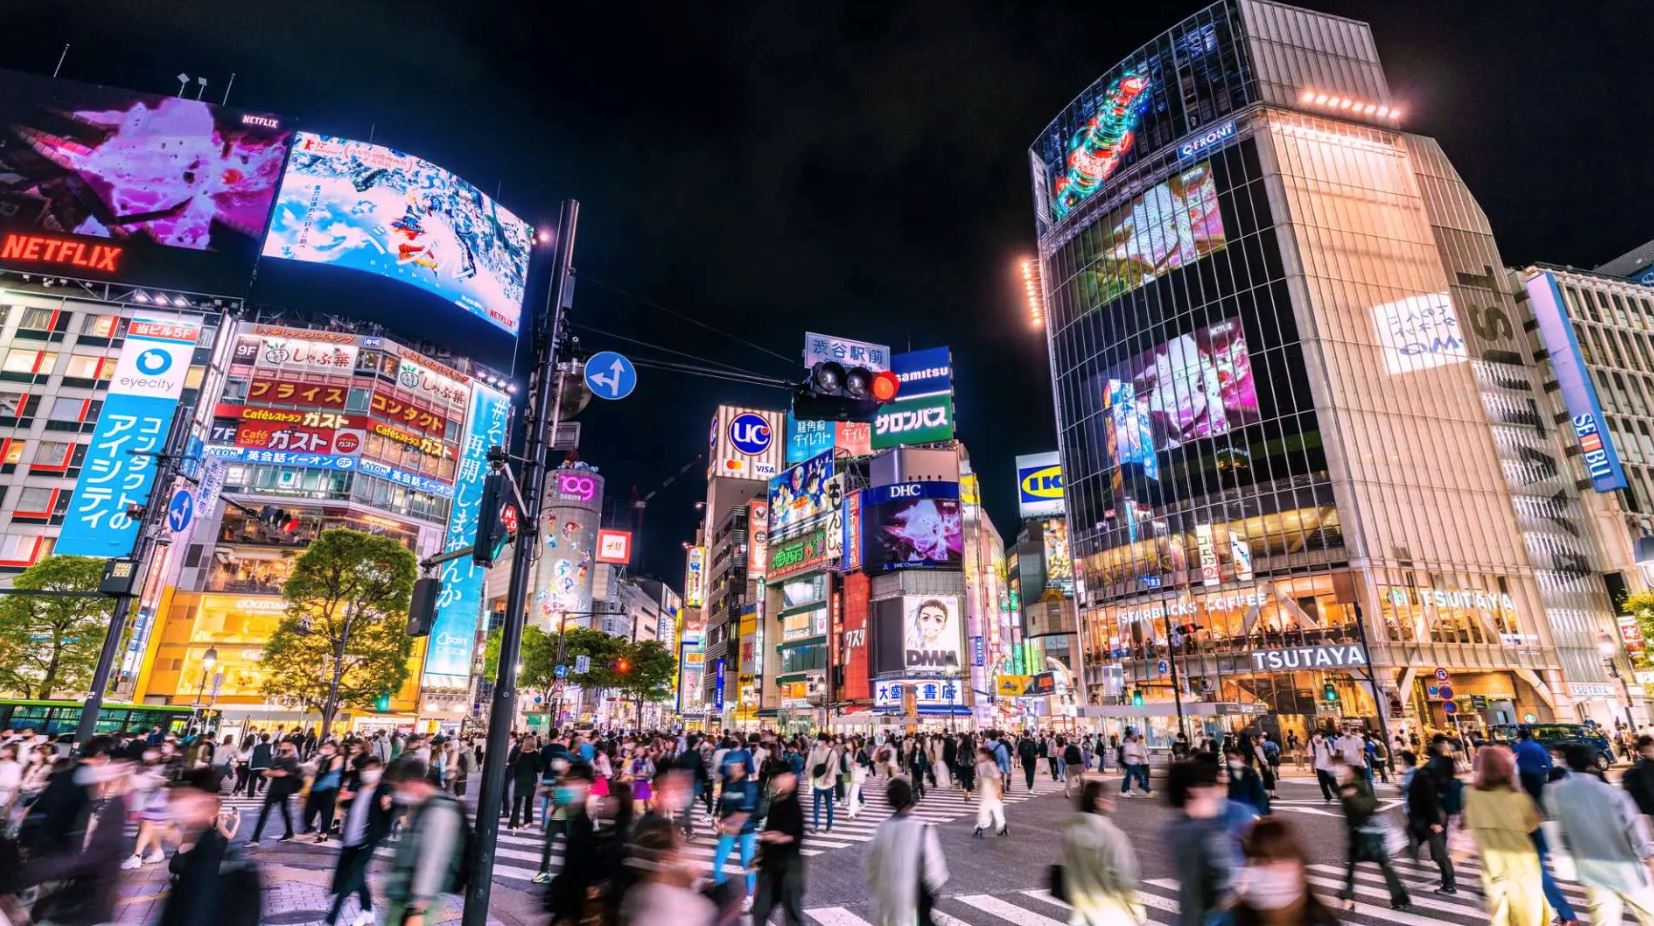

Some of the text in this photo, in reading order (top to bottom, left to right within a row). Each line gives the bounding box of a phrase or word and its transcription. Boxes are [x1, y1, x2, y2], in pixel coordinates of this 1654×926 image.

[242, 114, 279, 128] NETFLIX
[1, 234, 122, 272] NETFLIX
[489, 310, 514, 328] NETFLIX
[135, 323, 193, 339] 当ビル5F
[237, 344, 257, 356] 9F
[292, 347, 350, 367] しゃぶ葉
[813, 339, 883, 364] 渋谷駅前
[120, 376, 175, 391] eyecity
[251, 381, 344, 405] プライス
[422, 376, 465, 404] しゃぶ葉
[302, 411, 349, 429] ガスト
[371, 391, 443, 431] コンタクト
[874, 406, 948, 435] サロンパス
[212, 426, 237, 440] 7F
[241, 429, 268, 439] Café
[734, 422, 770, 445] UC
[1456, 265, 1592, 584] TSUTAYA
[268, 430, 327, 451] ガスト
[420, 438, 452, 458] ガスト
[1573, 412, 1612, 478] SEIBU
[247, 450, 334, 466] 英会話イーオン
[79, 414, 137, 529] アイシティ
[108, 417, 163, 530] コンタクトの
[755, 465, 775, 474] VISA
[391, 469, 454, 495] 英会話イーオン
[559, 476, 595, 500] 109
[890, 484, 921, 498] DHC
[437, 433, 485, 608] 再開しませんか
[827, 478, 843, 554] もんじゃ
[1204, 593, 1267, 611] COFFEE
[1420, 591, 1515, 610] TSUTAYA
[1253, 645, 1366, 670] TSUTAYA
[879, 683, 958, 700] 大盛書店
